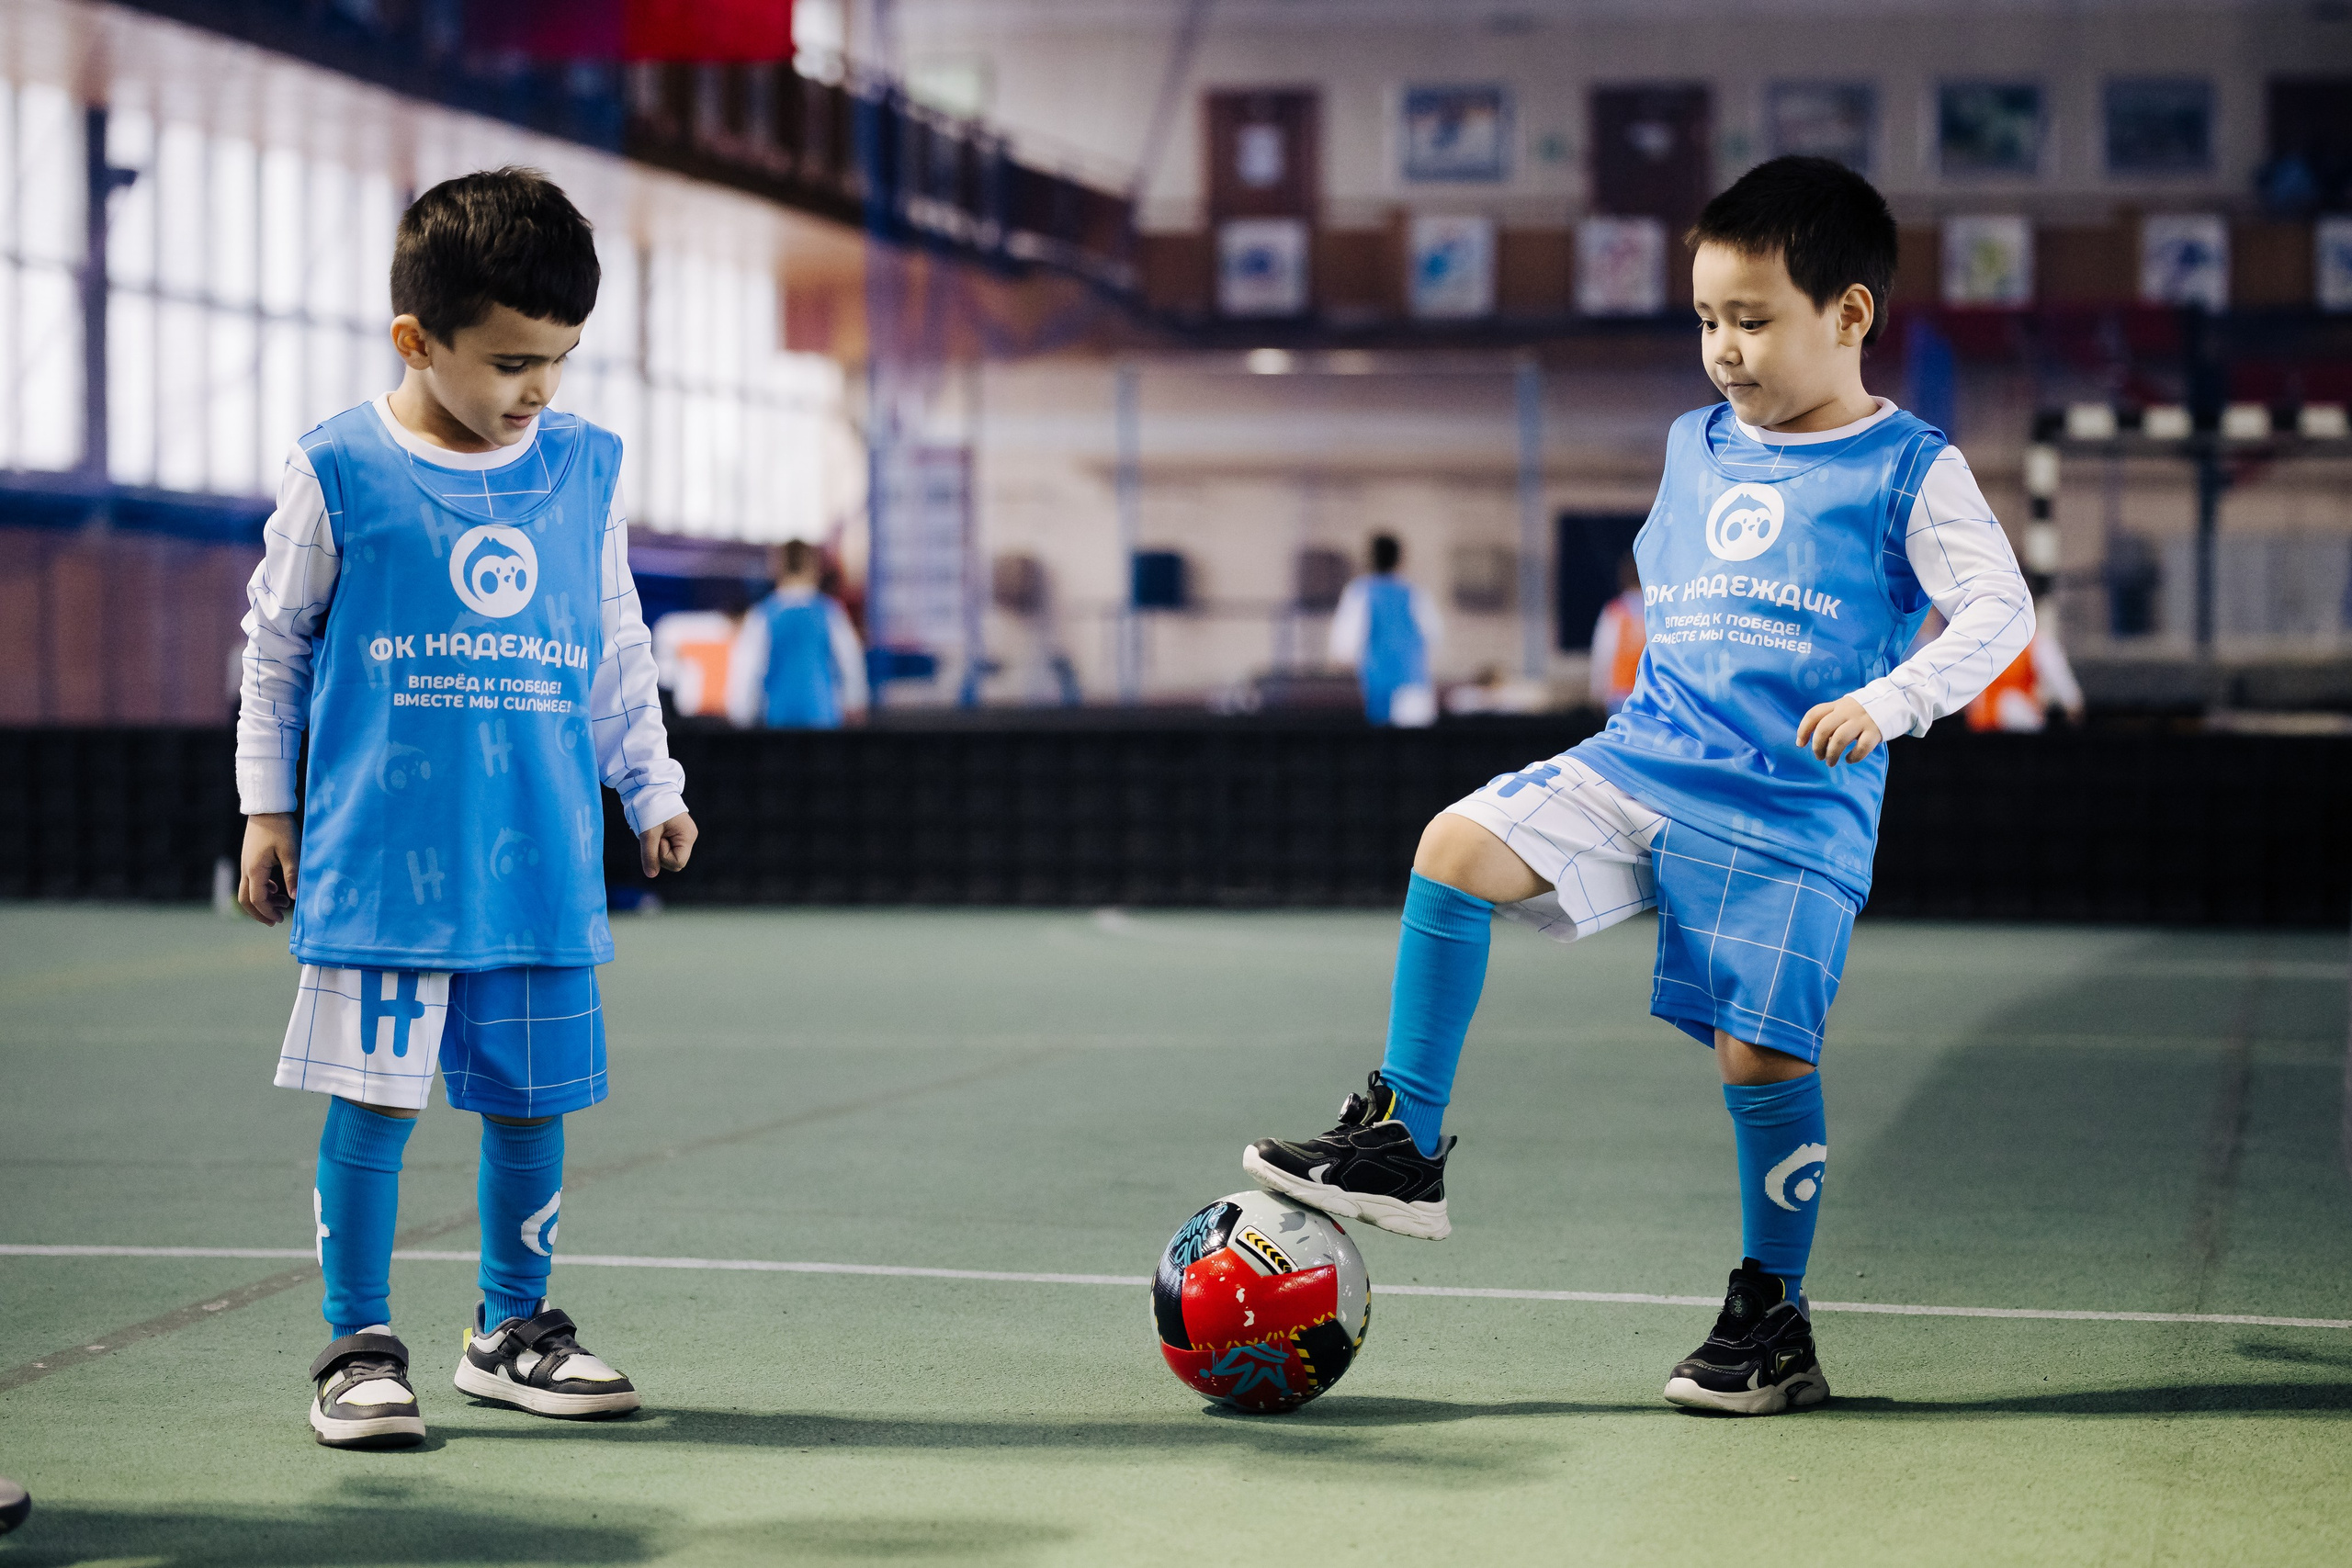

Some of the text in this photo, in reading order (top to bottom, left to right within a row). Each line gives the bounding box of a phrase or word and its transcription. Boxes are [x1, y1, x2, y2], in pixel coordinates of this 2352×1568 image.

[1681, 573, 1843, 620] НАДЕЖДИК
[1664, 612, 1802, 637] ВПЕРЁД К ПОБЕДЕ!
[369, 634, 417, 661] ФК
[1651, 628, 1813, 654] ВМЕСТЕ МЫ СИЛЬНЕЕ!
[408, 672, 562, 696] ВПЕРЁД К ПОБЕДЕ!
[393, 693, 572, 714] ВМЕСТЕ МЫ СИЛЬНЕЕ!
